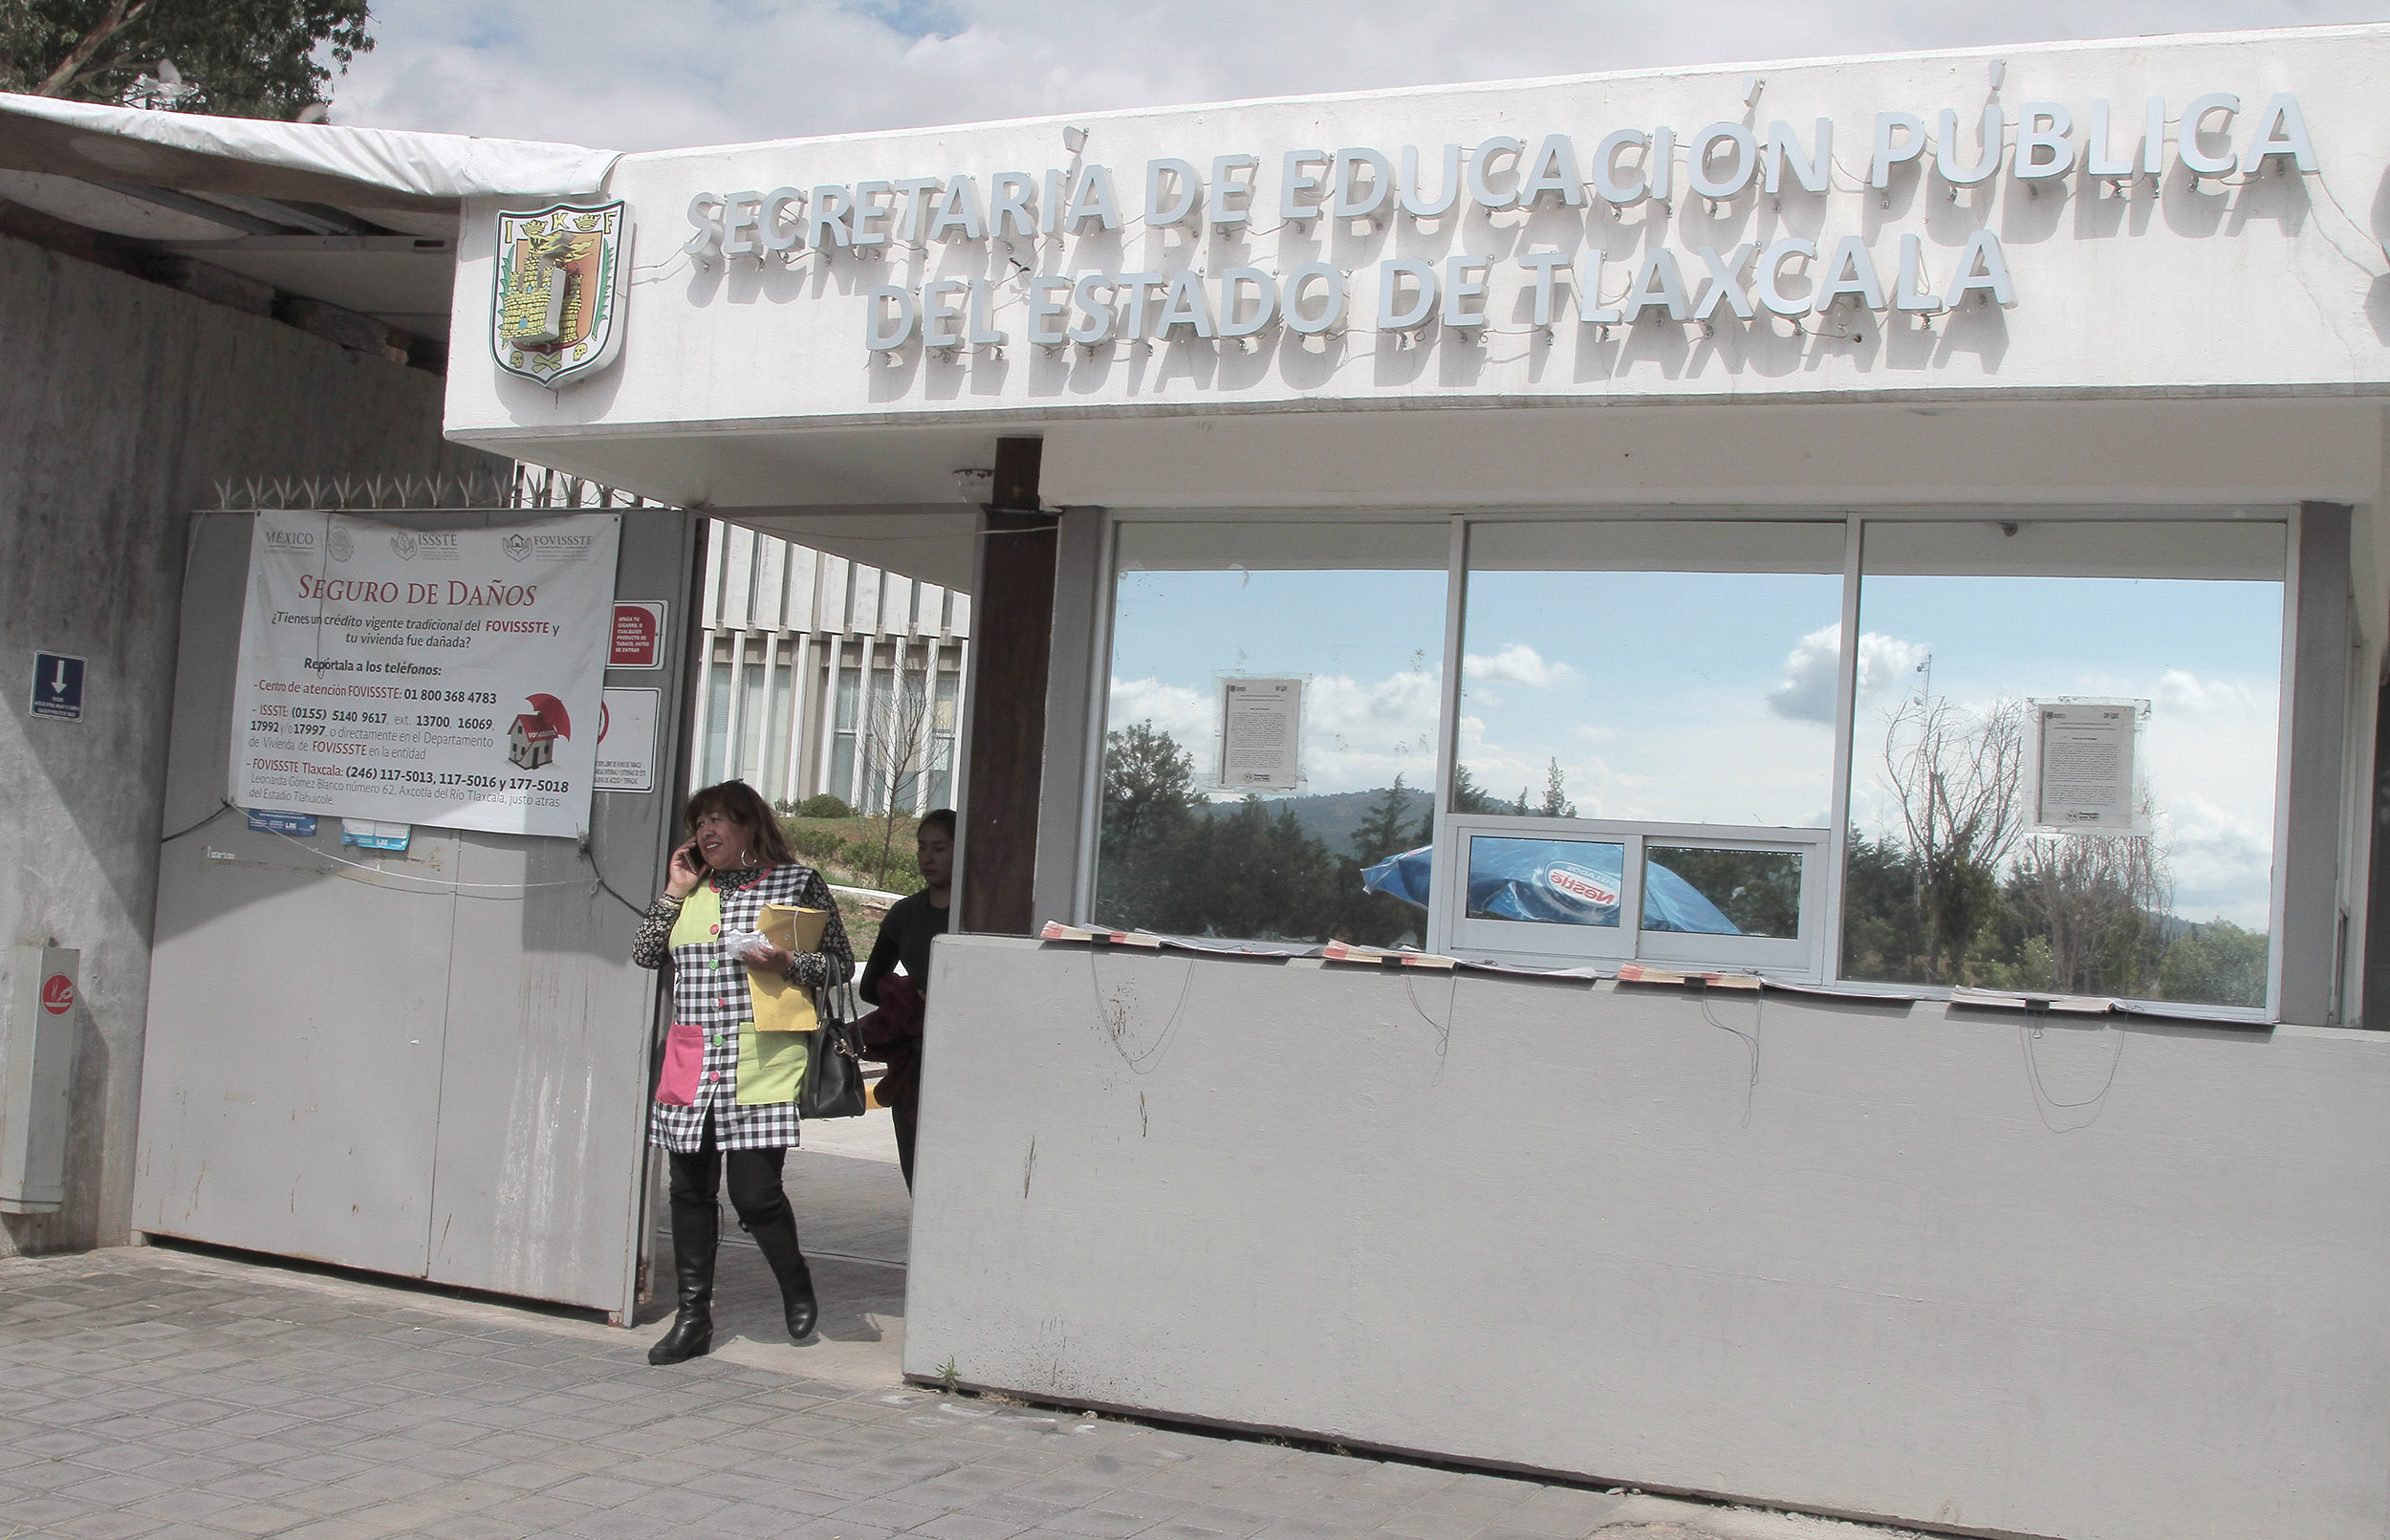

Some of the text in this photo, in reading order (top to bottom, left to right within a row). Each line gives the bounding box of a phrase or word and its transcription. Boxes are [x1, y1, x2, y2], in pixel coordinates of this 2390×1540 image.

[684, 59, 2317, 256] SECRETARÍA DE EDUCACIÓN PÚBLICA
[865, 228, 2016, 353] DEL ESTADO DE TLAXCALA
[266, 530, 314, 545] MÉXICO
[418, 533, 458, 546] ISSSTE
[533, 535, 593, 546] FOVISSSTE
[298, 574, 537, 606] SEGURO DE DAÑOS
[272, 611, 560, 637] ¿Tienes un crédito vigente tradicional del FOVISSSTE y
[345, 633, 471, 648] tu vivienda fue dañada?
[304, 658, 442, 676] Repórtala a los teléfonos:
[288, 681, 300, 693] de
[303, 683, 346, 697] atención
[348, 684, 402, 700] FOVISSSTE:
[404, 688, 418, 700] 01
[421, 689, 442, 702] 800
[444, 691, 465, 703] 368
[467, 692, 497, 704] 4783
[292, 706, 327, 721] (0155)
[332, 710, 358, 722] 5140
[394, 715, 411, 726] ext.
[250, 721, 279, 733] 17992
[338, 727, 398, 741] directamente
[400, 732, 411, 742] en
[412, 731, 421, 743] el
[424, 731, 493, 748] Departamento
[249, 737, 426, 760] de Vivienda de FOVISSSTE en la entidad
[302, 762, 343, 776] Tlaxcala:
[346, 766, 378, 780] (246)
[380, 769, 436, 785] 117-5013,
[439, 773, 496, 788] 117-5016
[499, 780, 507, 792] y
[509, 777, 569, 793] 177-5018
[249, 787, 335, 805] del Estadio Tlahuicole.
[250, 773, 560, 808] Leonarda Gómez Blanco número 62, Axcotla del Río Tlaxcala, justo atras
